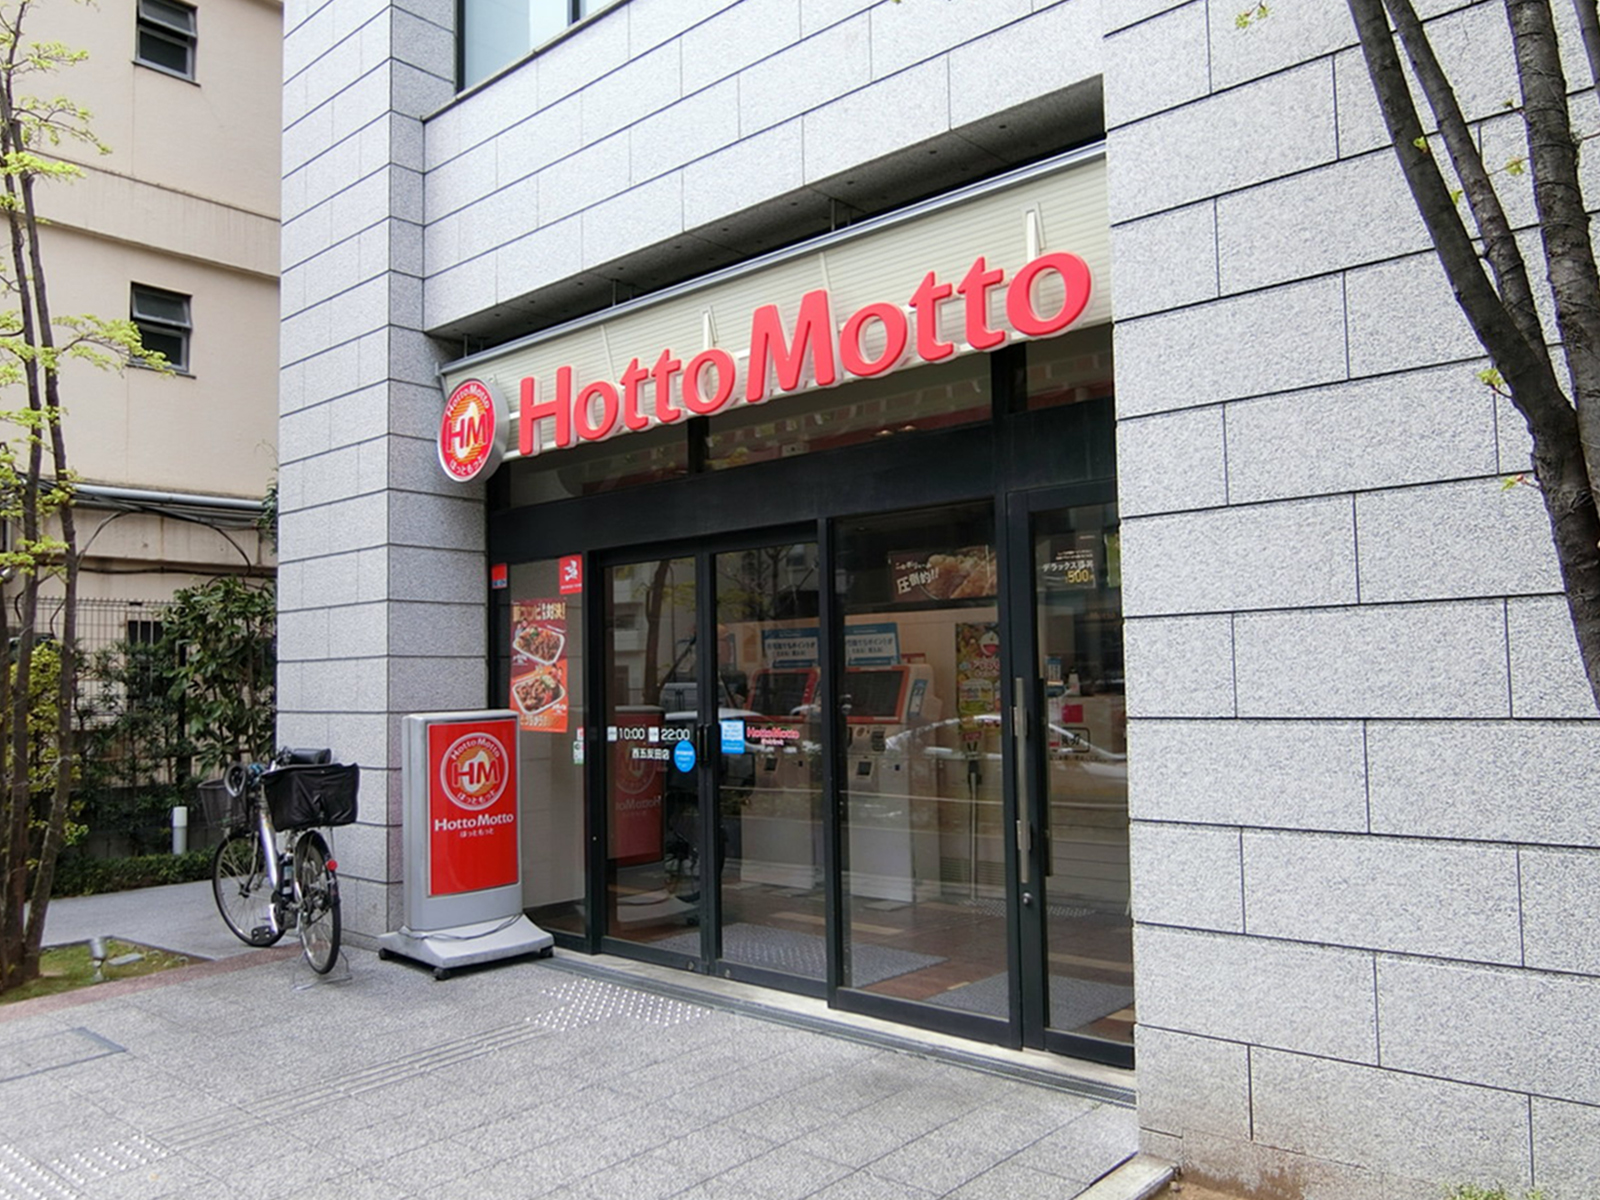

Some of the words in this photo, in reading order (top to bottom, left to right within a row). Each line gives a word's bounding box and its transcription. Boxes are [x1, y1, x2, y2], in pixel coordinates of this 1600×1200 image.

[519, 252, 1092, 456] HottoMotto
[446, 412, 488, 453] HM
[619, 728, 645, 740] 10:00
[661, 728, 690, 741] 22:00
[450, 738, 500, 760] HottoMotto
[452, 759, 500, 787] HM
[434, 813, 514, 832] HottoMotto
